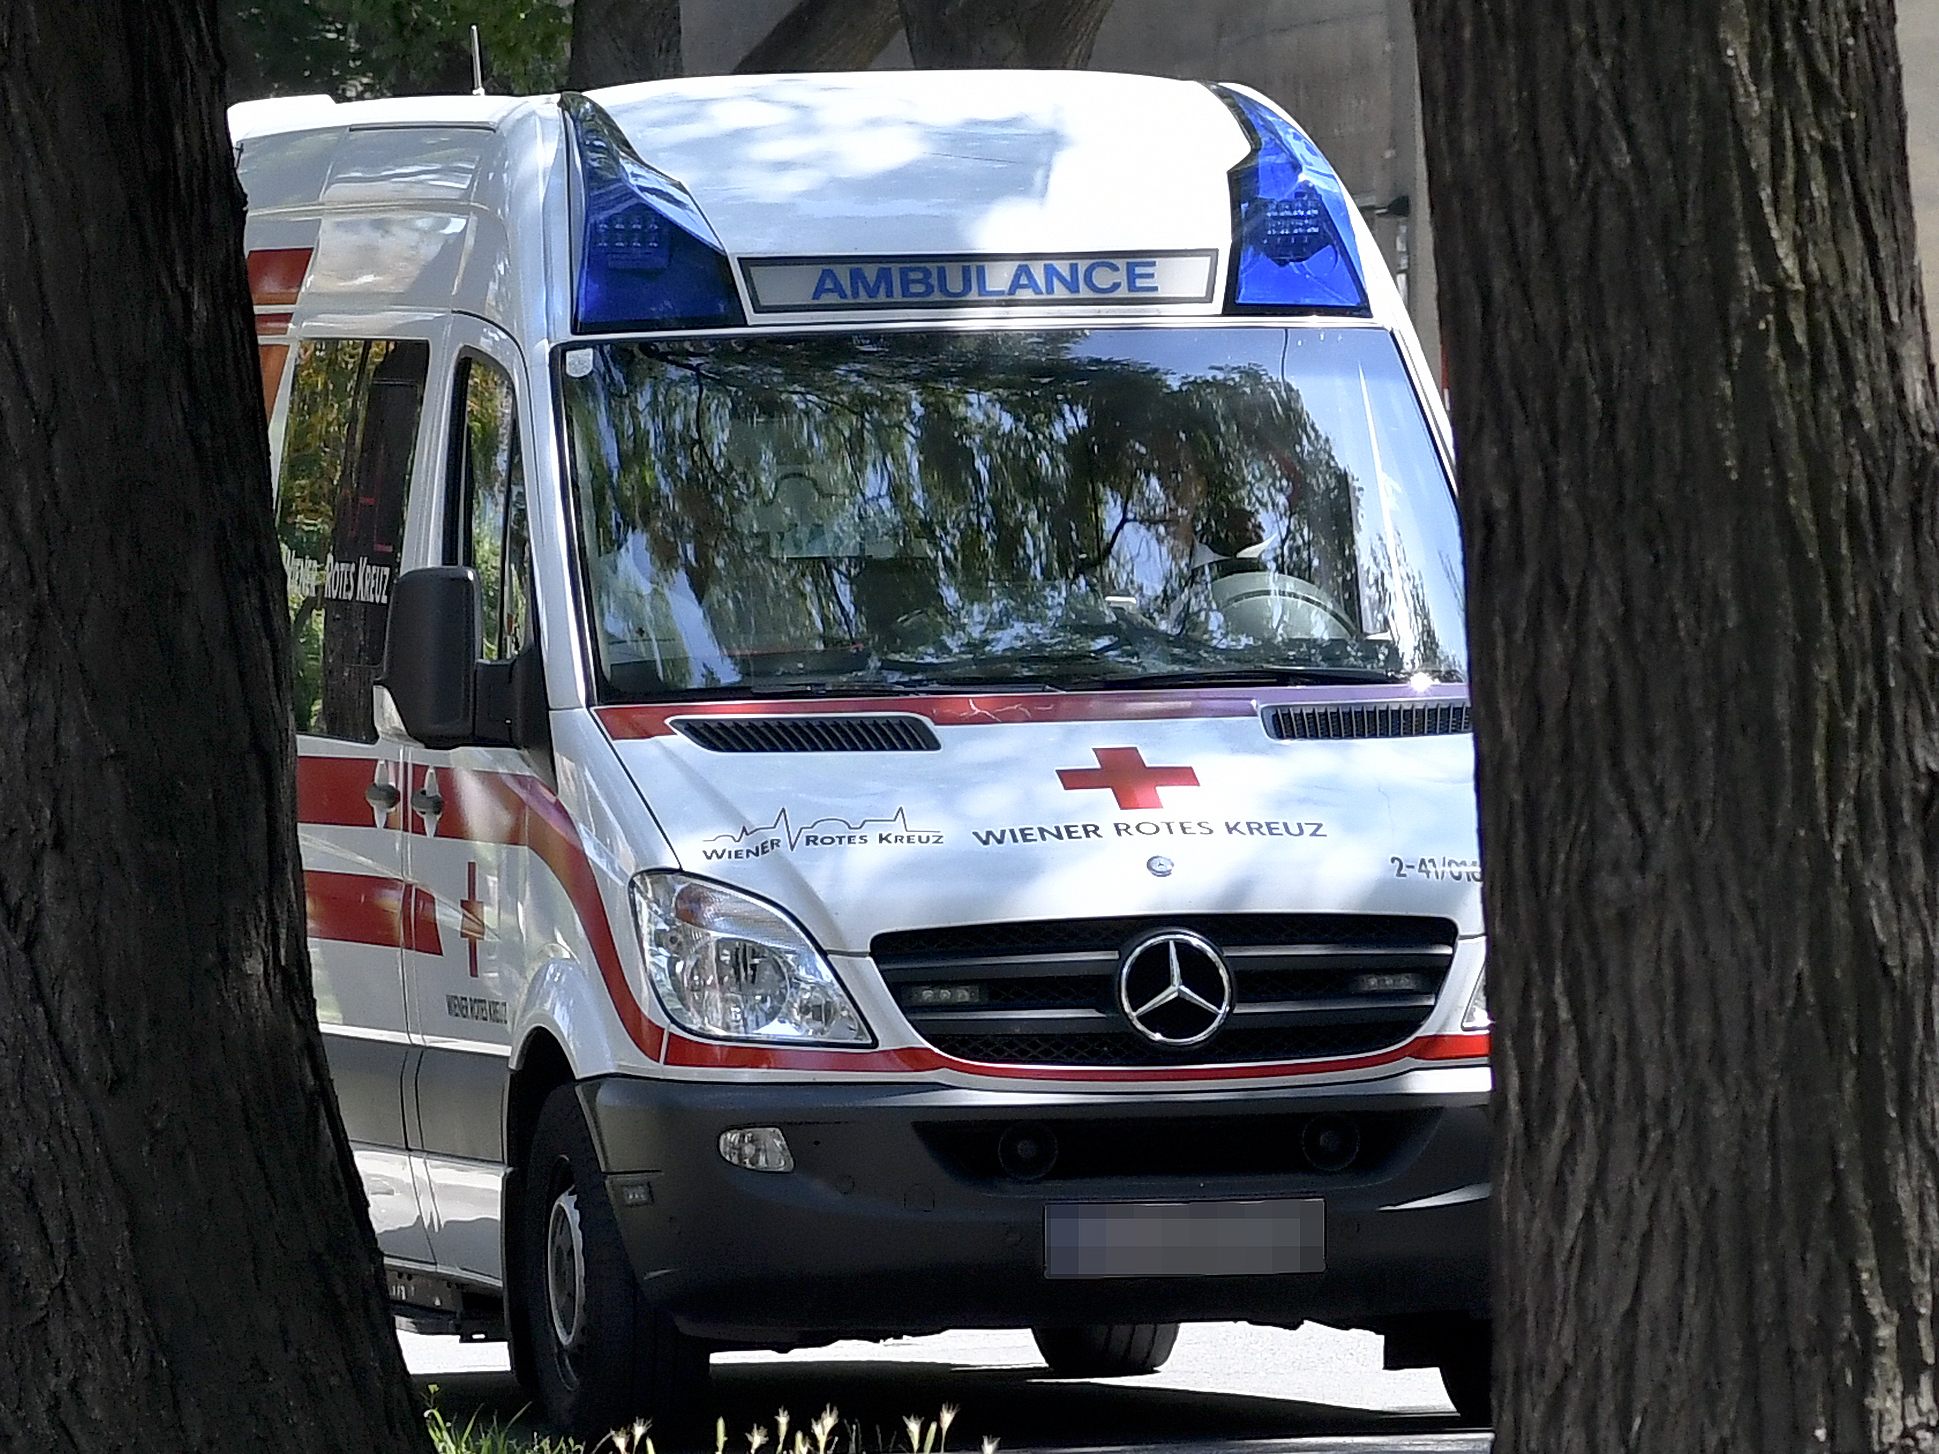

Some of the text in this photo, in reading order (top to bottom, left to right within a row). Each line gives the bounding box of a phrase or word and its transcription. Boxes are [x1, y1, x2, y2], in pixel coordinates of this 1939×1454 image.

[812, 260, 1159, 300] AMBULANCE
[324, 552, 356, 600] ROTES
[356, 556, 391, 604] KREUZ
[702, 832, 944, 860] WIENER ROTES KREUZ
[972, 821, 1328, 847] WIENER ROTES KREUZ
